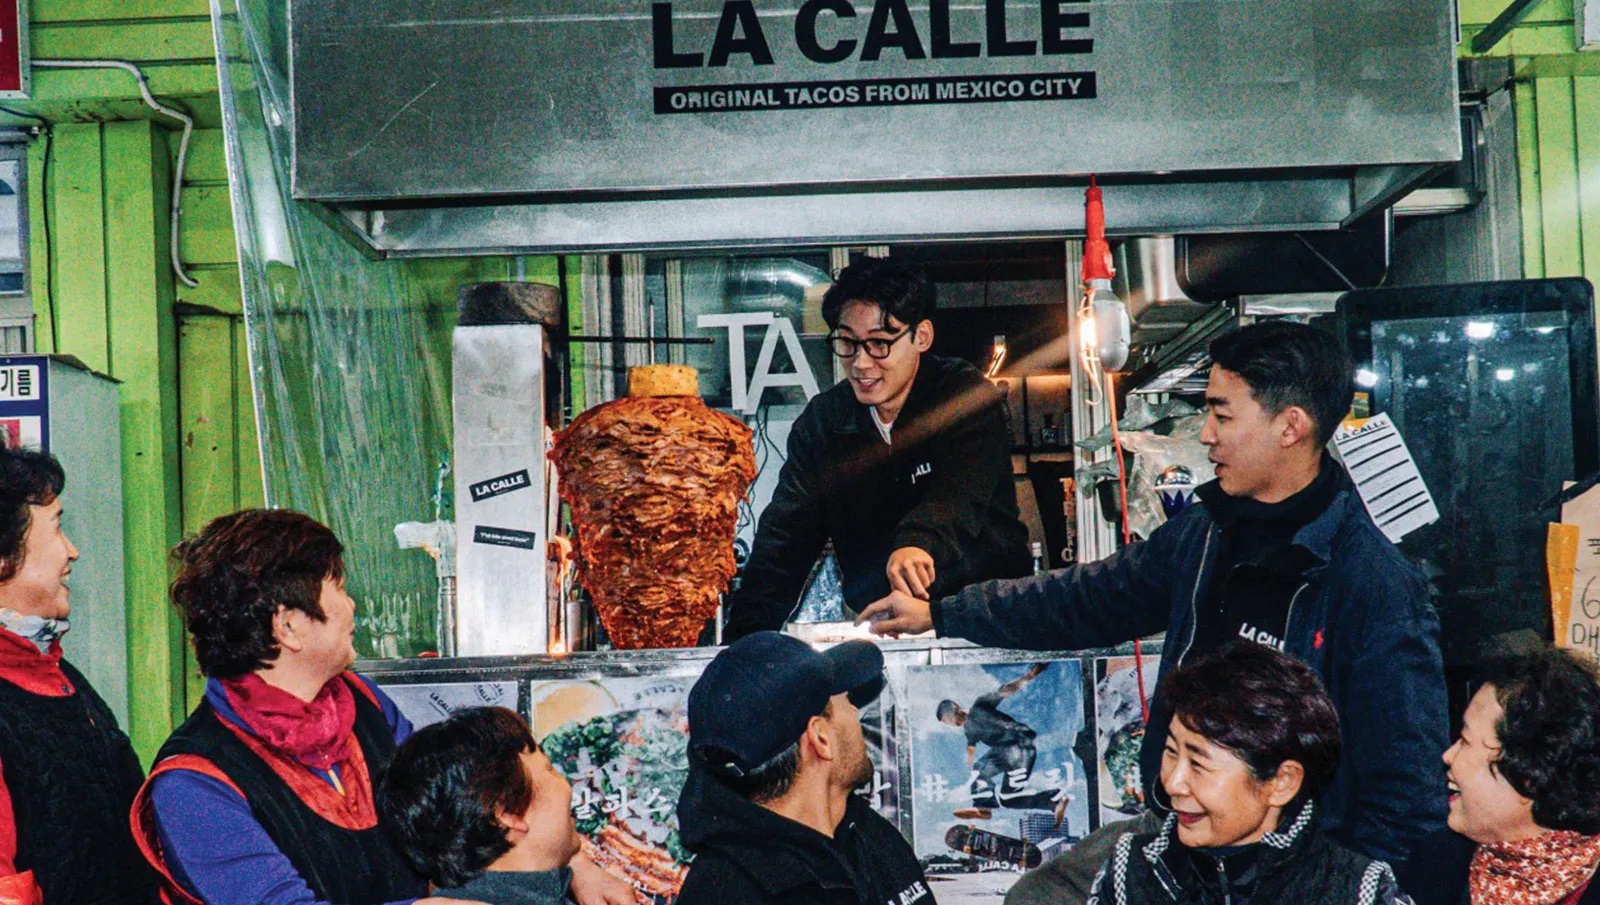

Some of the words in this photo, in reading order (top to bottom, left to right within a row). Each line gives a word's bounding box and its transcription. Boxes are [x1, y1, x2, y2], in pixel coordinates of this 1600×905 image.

[652, 0, 775, 69] LA
[795, 0, 1094, 64] CALLE
[670, 88, 780, 109] ORIGINAL
[784, 85, 860, 105] TACOS
[865, 84, 930, 102] FROM
[935, 80, 1025, 100] MEXICO
[1030, 78, 1082, 96] CITY
[1, 368, 31, 397] 기름
[475, 484, 491, 496] LA
[490, 474, 525, 491] CALLE
[1238, 622, 1257, 642] LA
